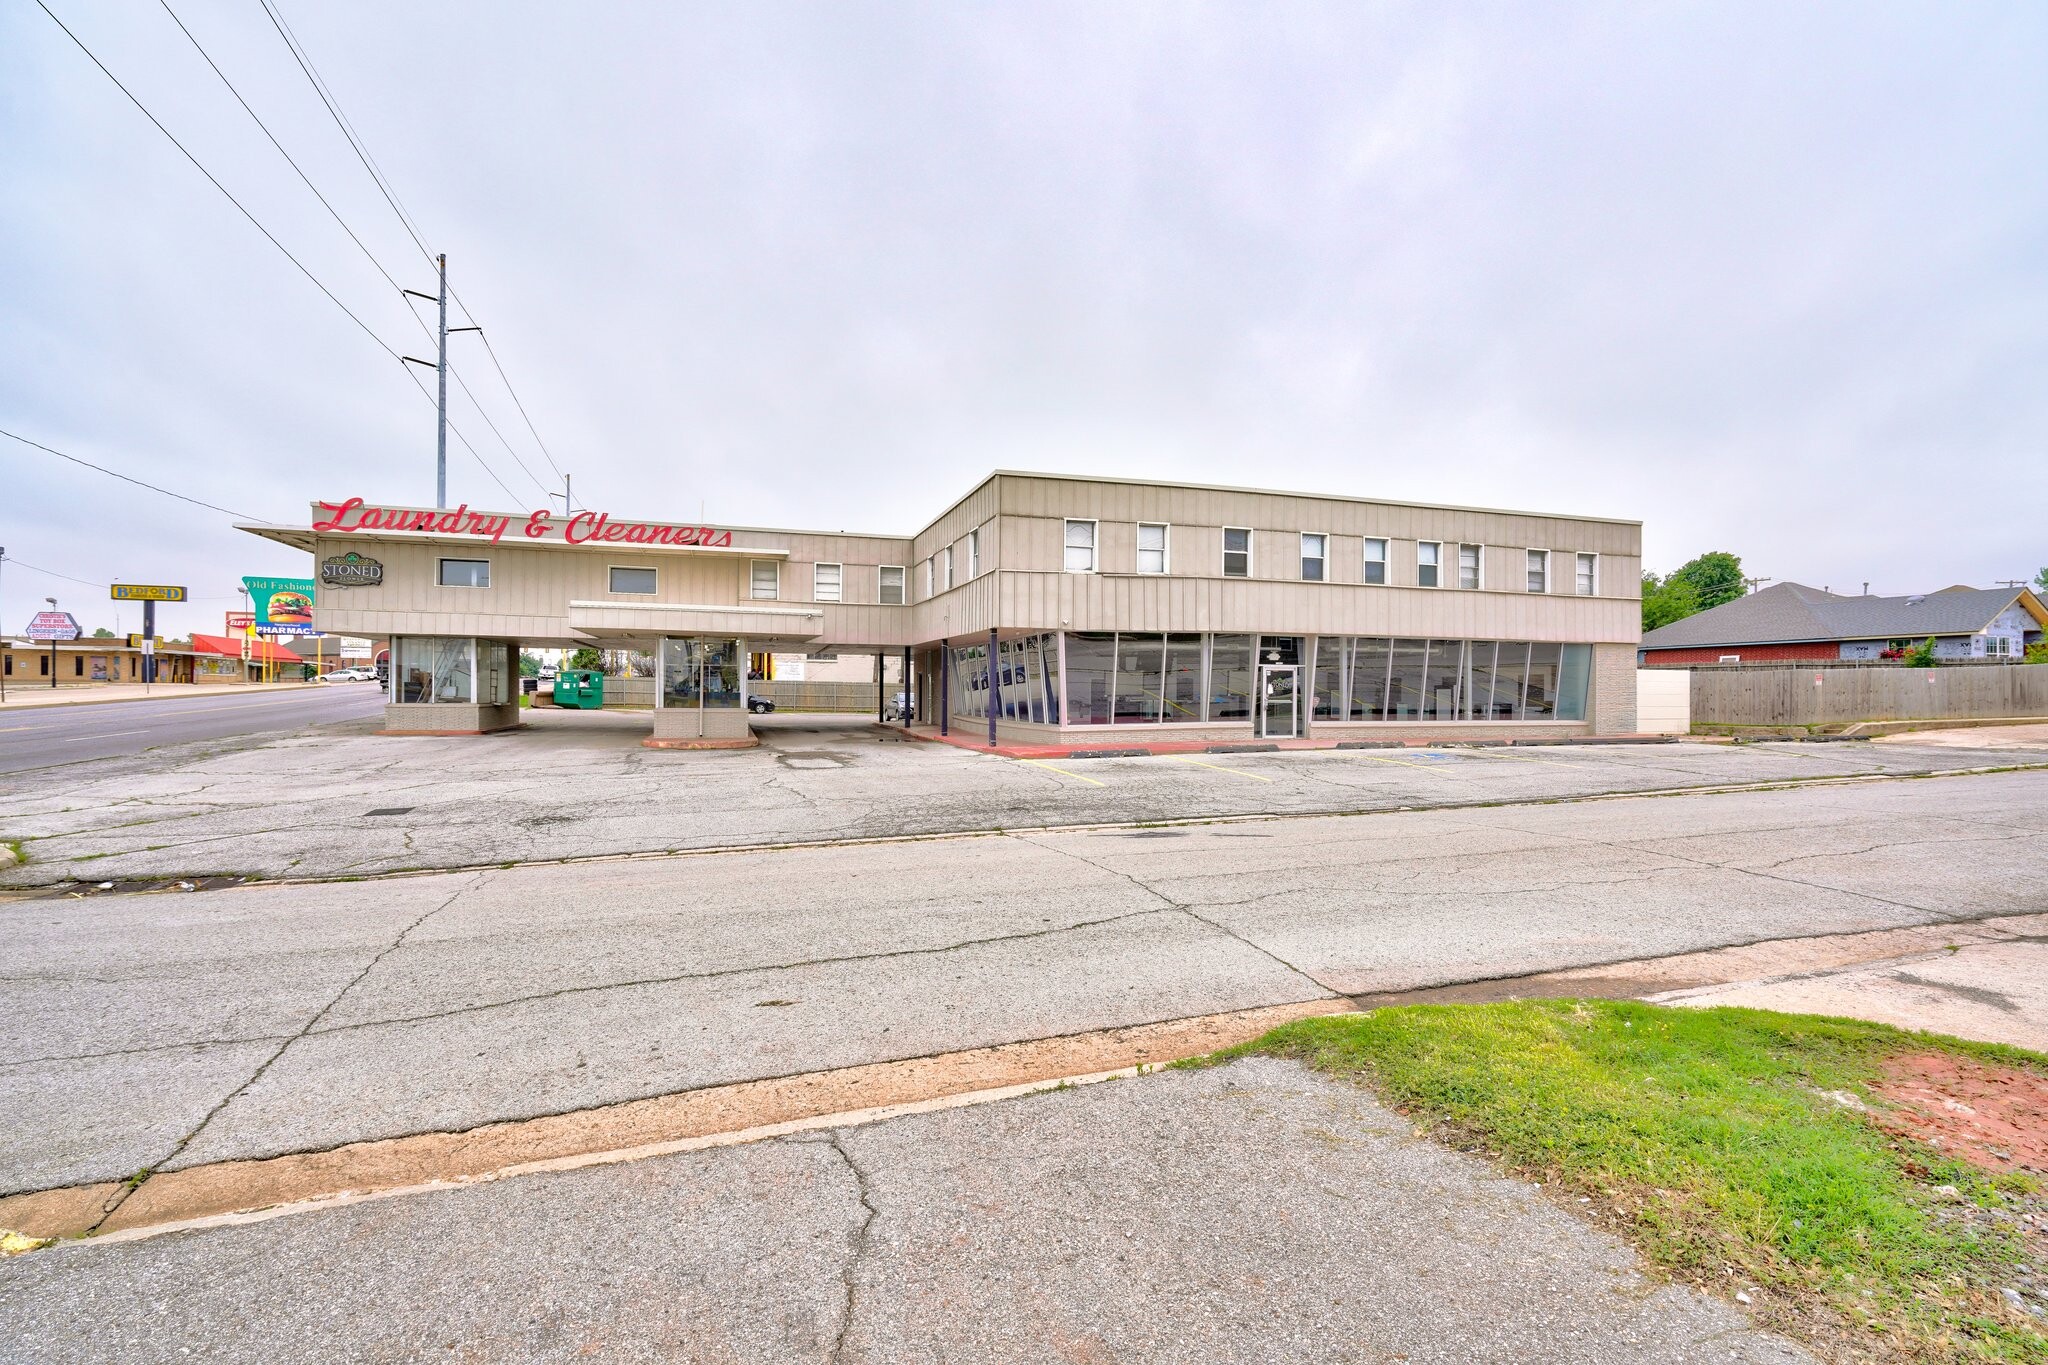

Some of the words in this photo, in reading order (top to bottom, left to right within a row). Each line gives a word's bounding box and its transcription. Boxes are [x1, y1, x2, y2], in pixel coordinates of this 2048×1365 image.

[312, 497, 510, 545] Laundry
[524, 509, 554, 538] &
[565, 511, 732, 548] Cleaners
[323, 564, 381, 578] STONED
[246, 580, 267, 589] Old
[117, 586, 179, 599] BEDFORD
